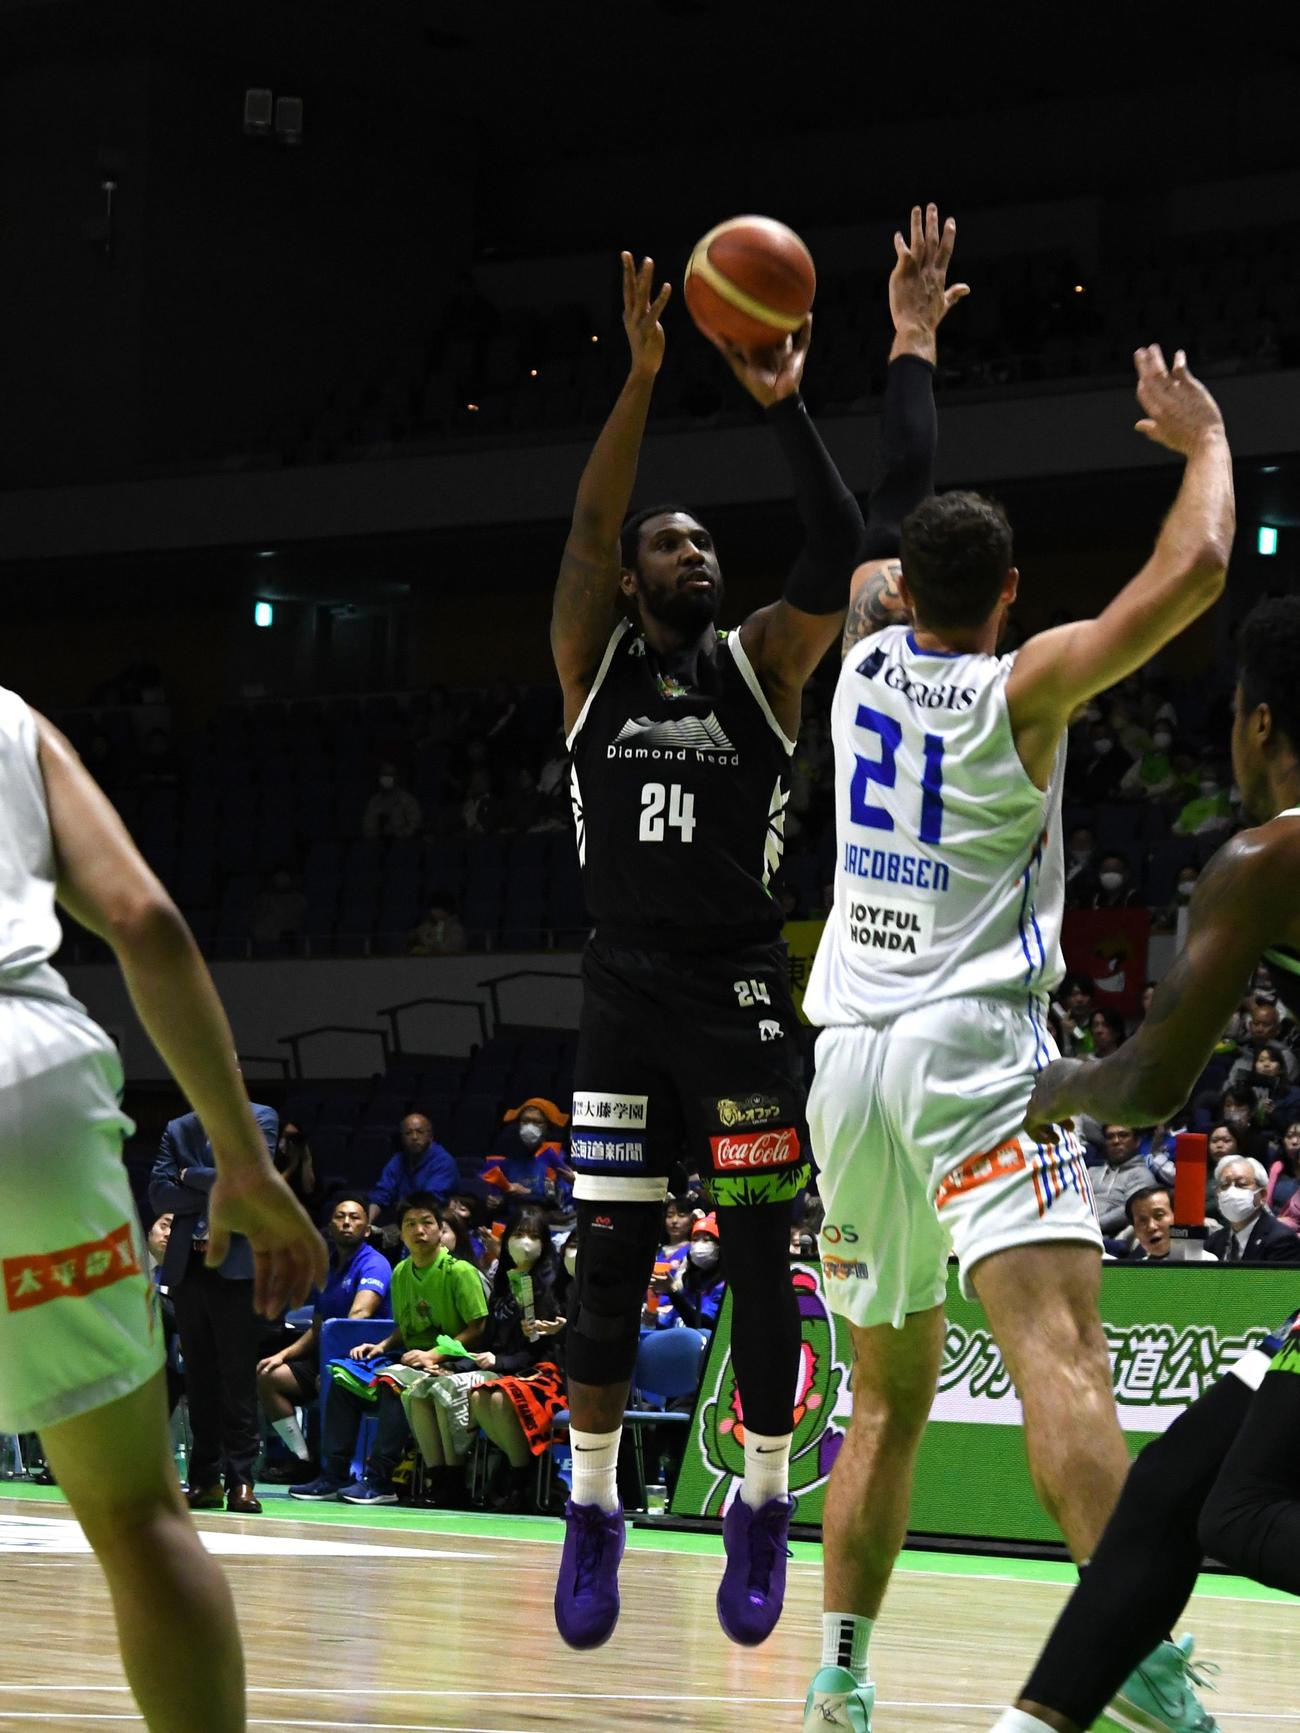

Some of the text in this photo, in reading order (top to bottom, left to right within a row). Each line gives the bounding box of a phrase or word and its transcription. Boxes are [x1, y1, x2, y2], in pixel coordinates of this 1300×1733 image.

[607, 745, 739, 766] Diamond head
[850, 703, 945, 845] 21
[639, 782, 697, 843] 24
[844, 842, 949, 892] JACOBSEN
[850, 901, 922, 933] JOYFUL
[850, 923, 917, 955] HONDA
[733, 979, 771, 1008] 24
